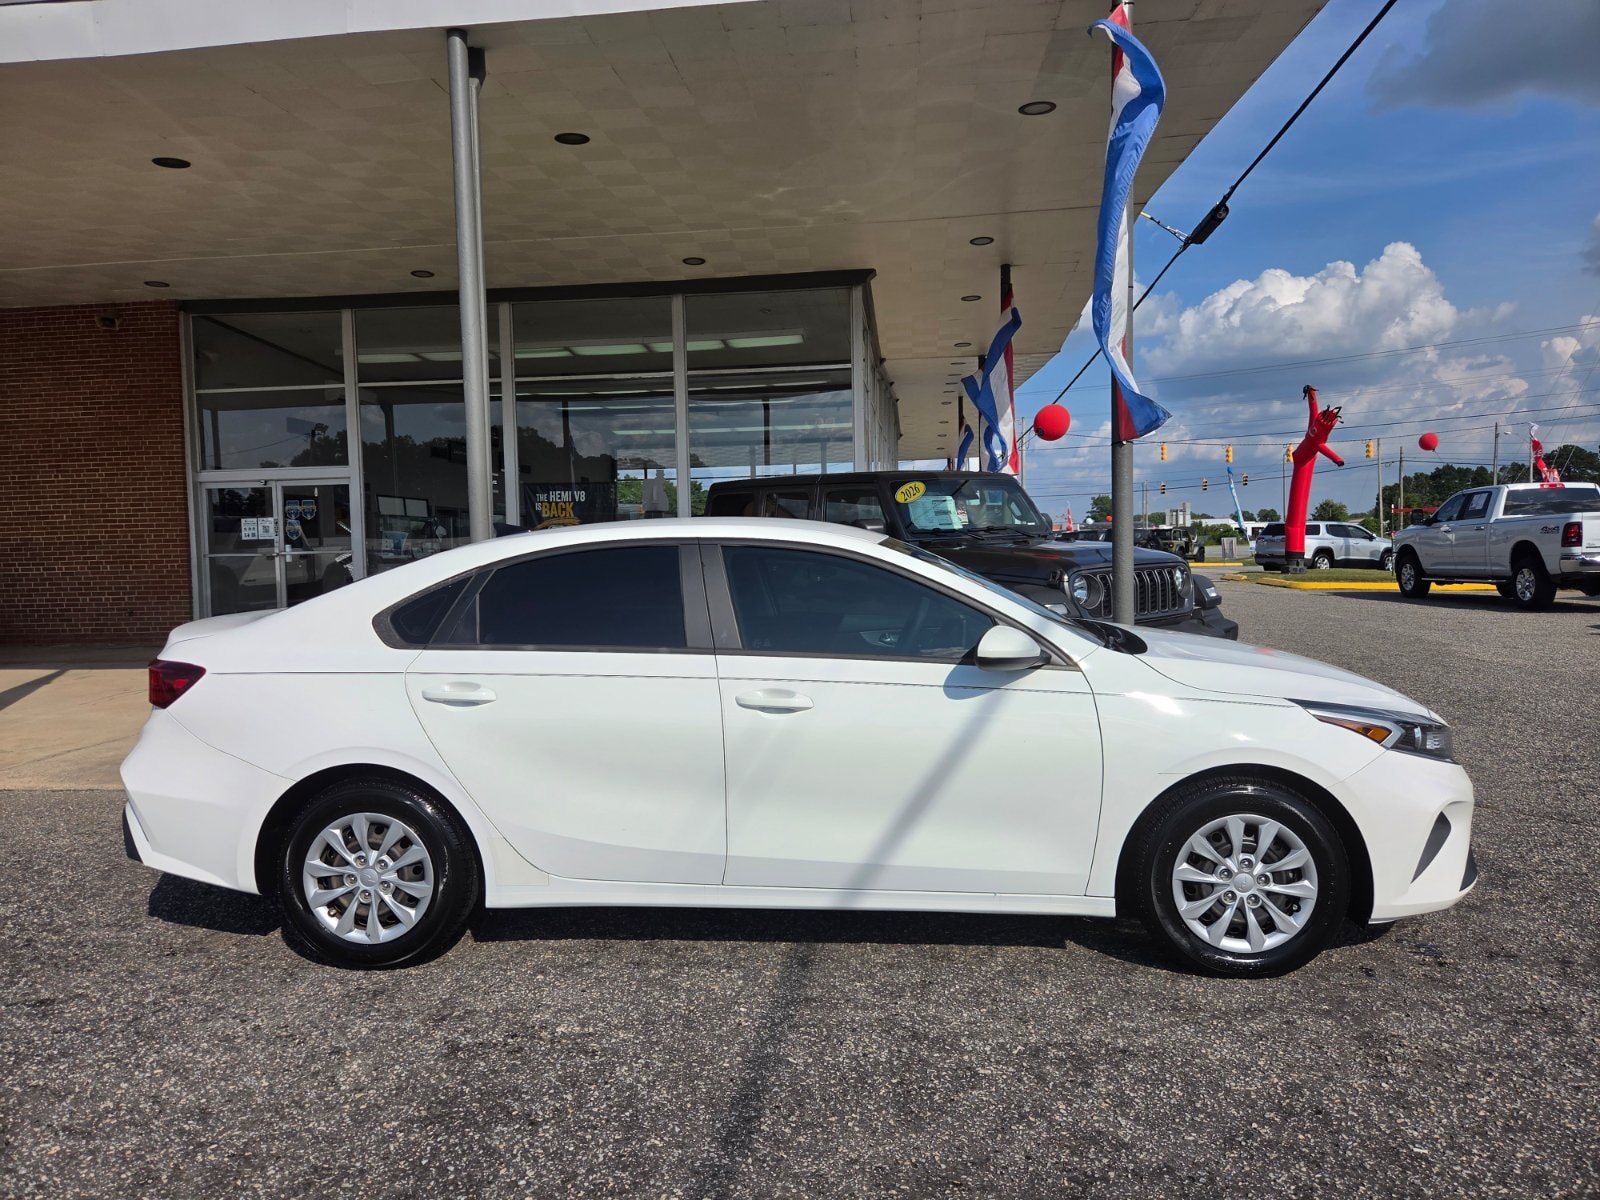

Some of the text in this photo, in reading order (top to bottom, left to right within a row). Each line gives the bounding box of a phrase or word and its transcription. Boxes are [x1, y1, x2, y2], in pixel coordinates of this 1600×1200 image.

[536, 490, 586, 502] THE HEMI V8
[900, 484, 921, 502] 2026
[535, 502, 575, 518] IS BACK
